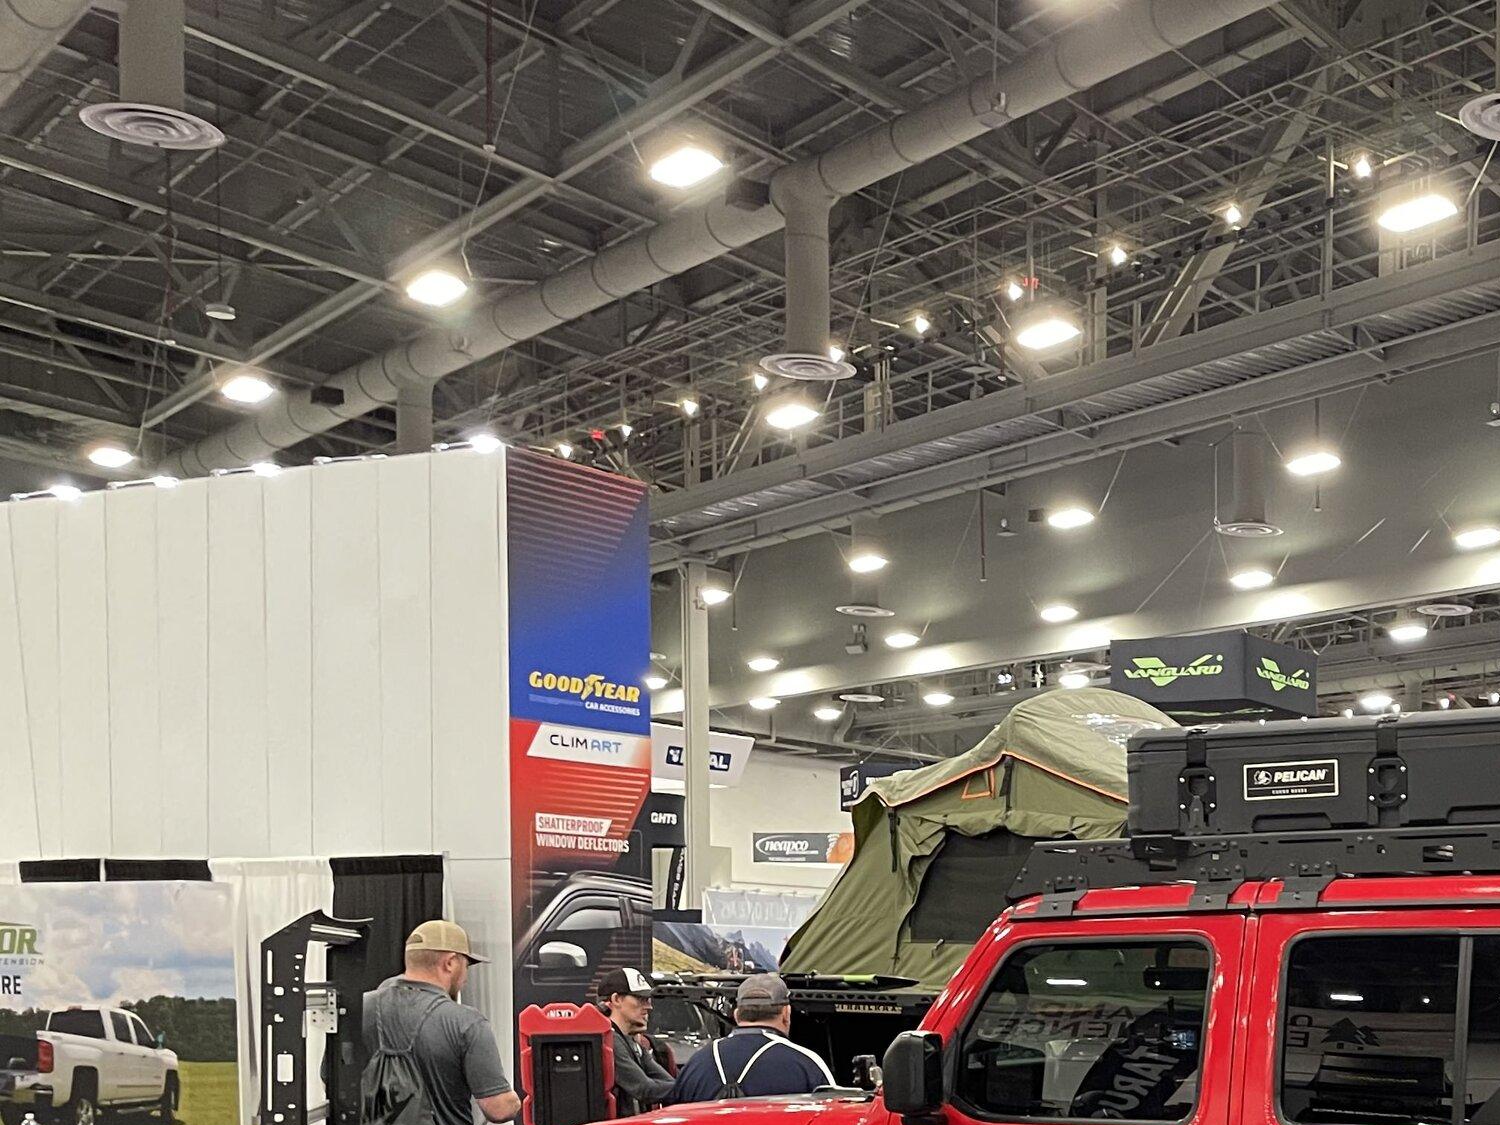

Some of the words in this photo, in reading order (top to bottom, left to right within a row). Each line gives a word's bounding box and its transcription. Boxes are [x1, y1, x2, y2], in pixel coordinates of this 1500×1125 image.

[529, 671, 641, 702] GOODYEAR
[585, 701, 599, 711] CAR
[599, 703, 641, 717] ACCESSORIES
[549, 734, 622, 753] CLIMART
[1273, 769, 1327, 783] PELICAN
[538, 816, 604, 834] SHATTERPROOF
[536, 833, 576, 849] WINDOW
[577, 836, 630, 853] DEFLECTORS
